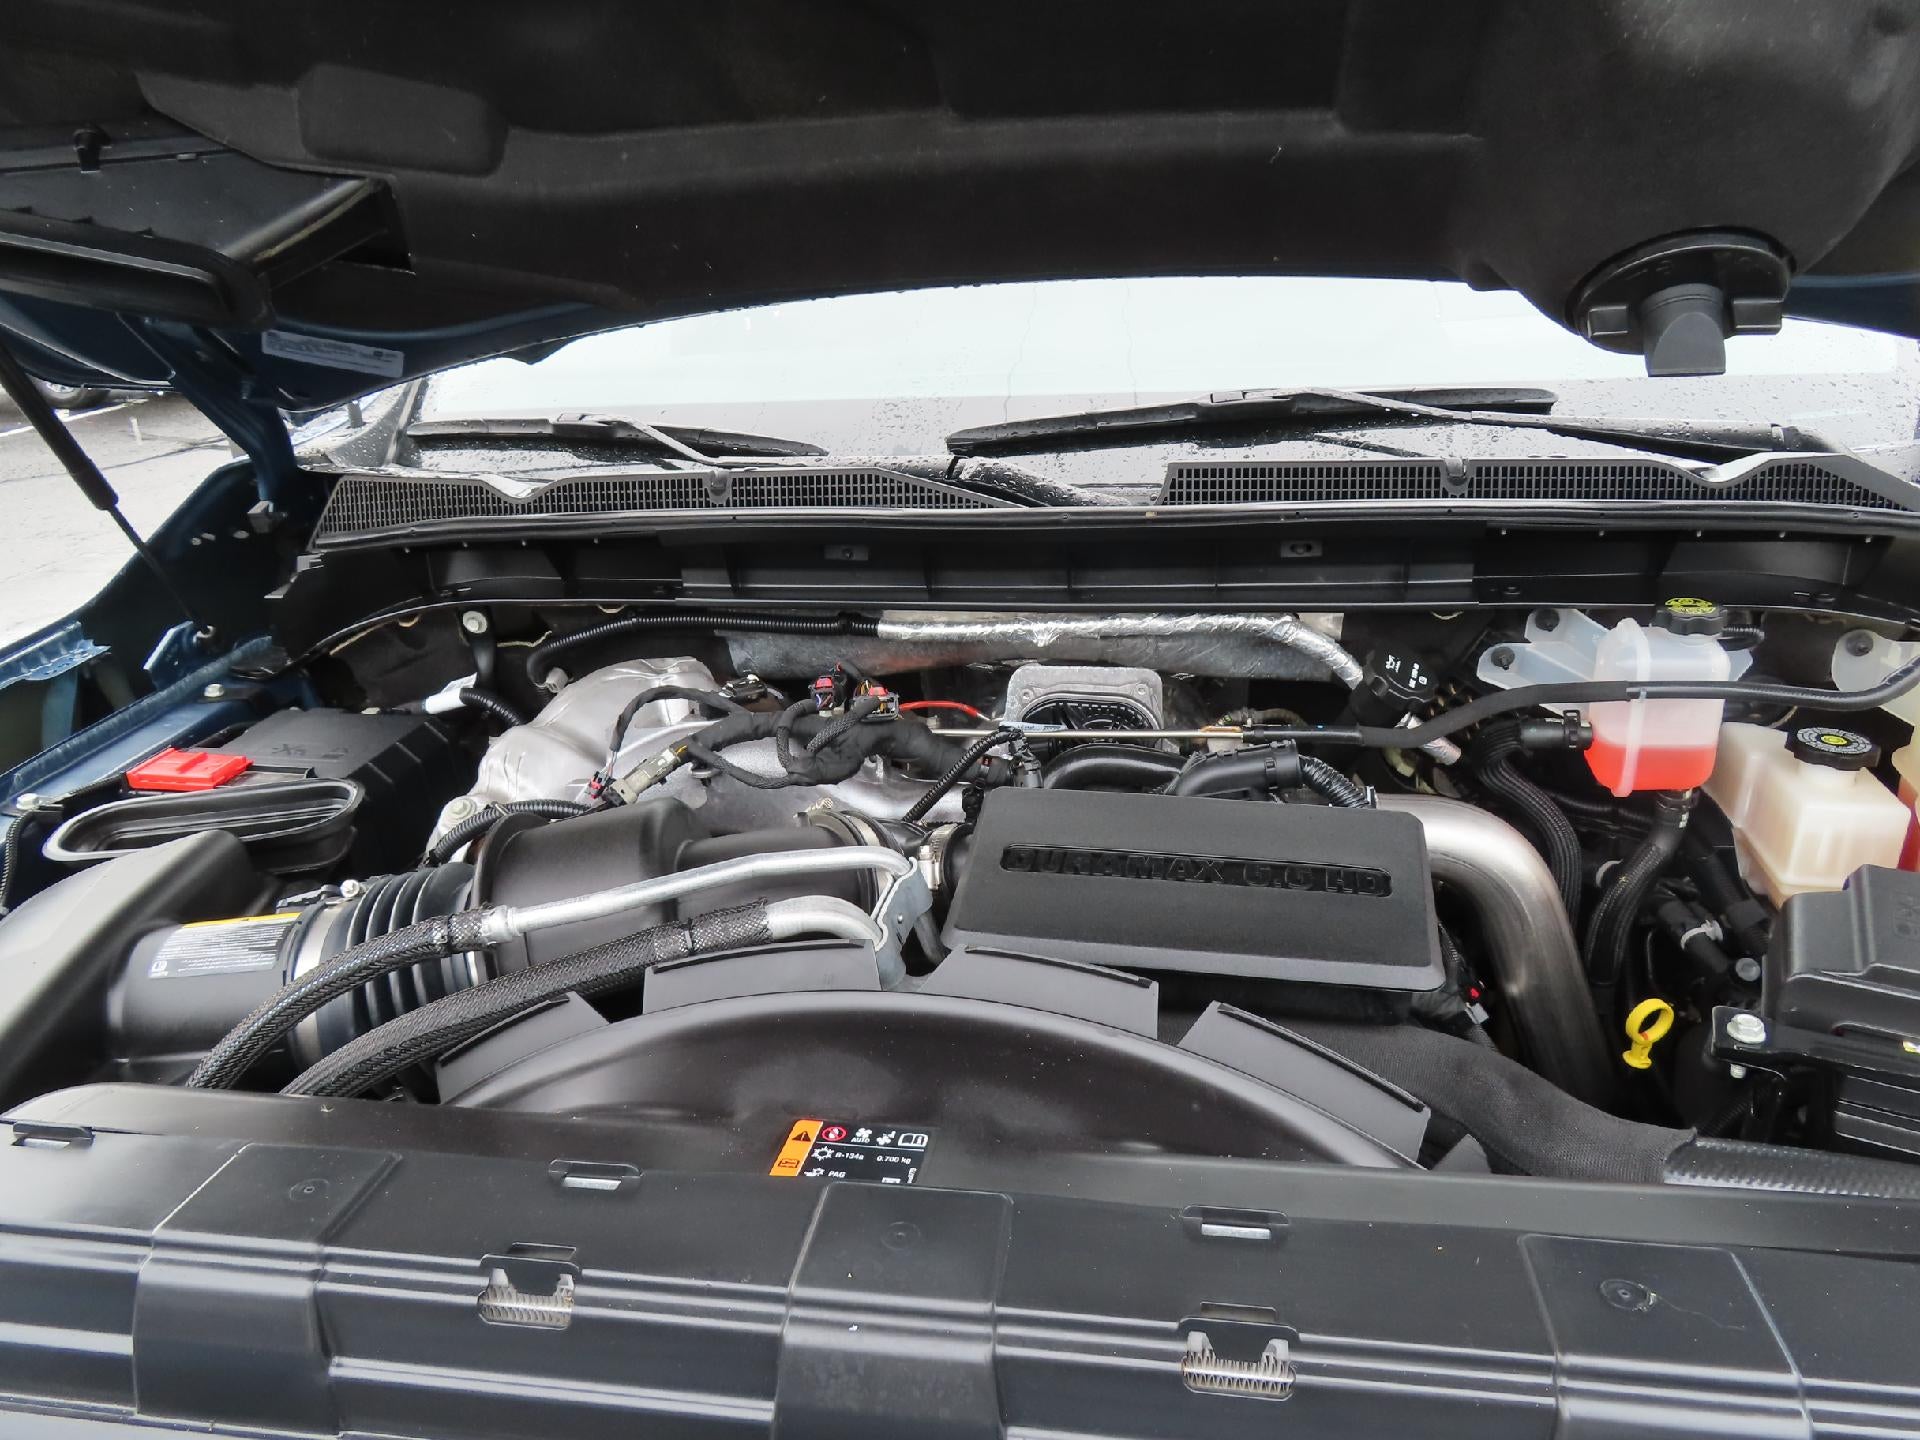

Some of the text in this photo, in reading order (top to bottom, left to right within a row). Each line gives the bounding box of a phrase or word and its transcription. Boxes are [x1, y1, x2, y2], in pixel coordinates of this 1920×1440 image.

[1003, 847, 1224, 883] DURAMAX
[1325, 868, 1391, 896] HD
[835, 1152, 864, 1160] R-134a
[876, 1155, 900, 1163] 0.700
[828, 1170, 846, 1178] PAG
